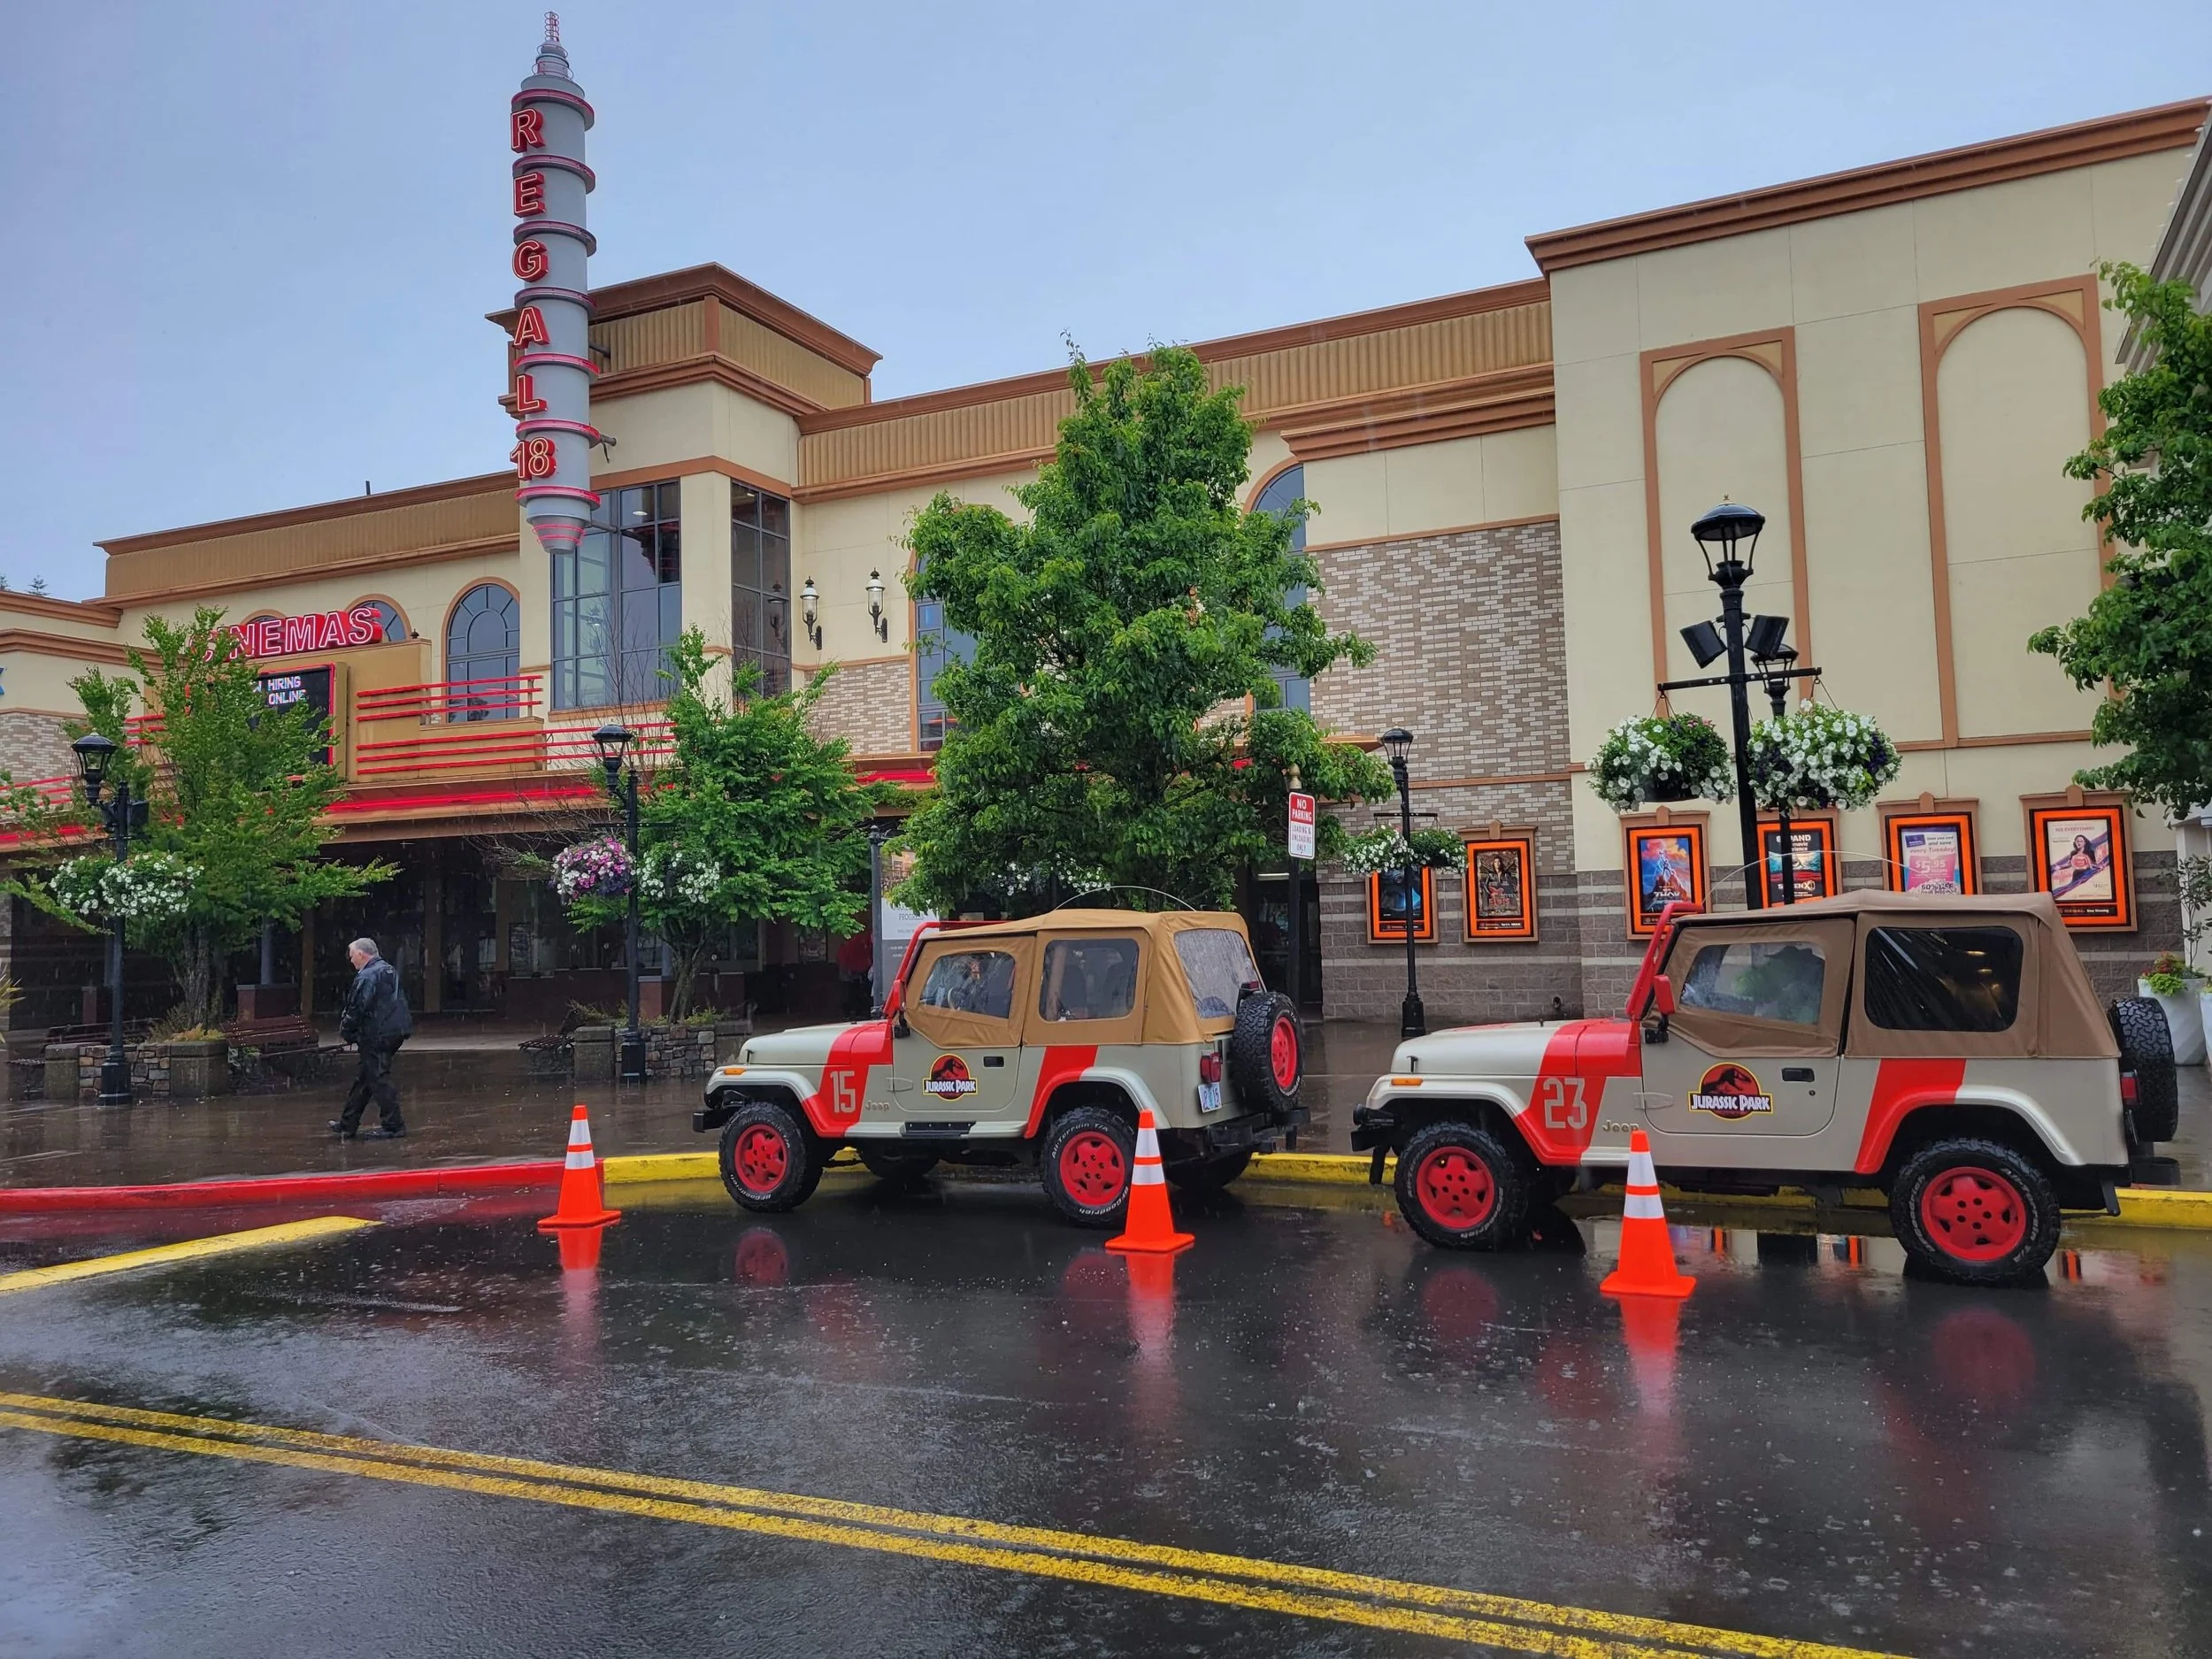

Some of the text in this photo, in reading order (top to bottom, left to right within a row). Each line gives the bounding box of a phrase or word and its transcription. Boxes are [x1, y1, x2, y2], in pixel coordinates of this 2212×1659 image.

[511, 107, 549, 422] REGAL
[510, 437, 556, 480] 18
[188, 607, 382, 662] NEMAS
[267, 676, 301, 691] HIRING
[268, 689, 306, 705] ONLINE
[1296, 798, 1307, 810] NO
[1292, 808, 1312, 821] PARKING
[1292, 825, 1308, 834] LOADING
[1292, 833, 1312, 843] UNLOADING
[830, 1070, 856, 1113] 15
[925, 1079, 976, 1093] JURASSIC PARK
[865, 1099, 890, 1111] Jeep
[1543, 1077, 1586, 1129] 23
[1691, 1094, 1770, 1110] JURASSIC PARK
[1094, 1122, 1110, 1133] T/A
[1601, 1119, 1640, 1133] Jeep
